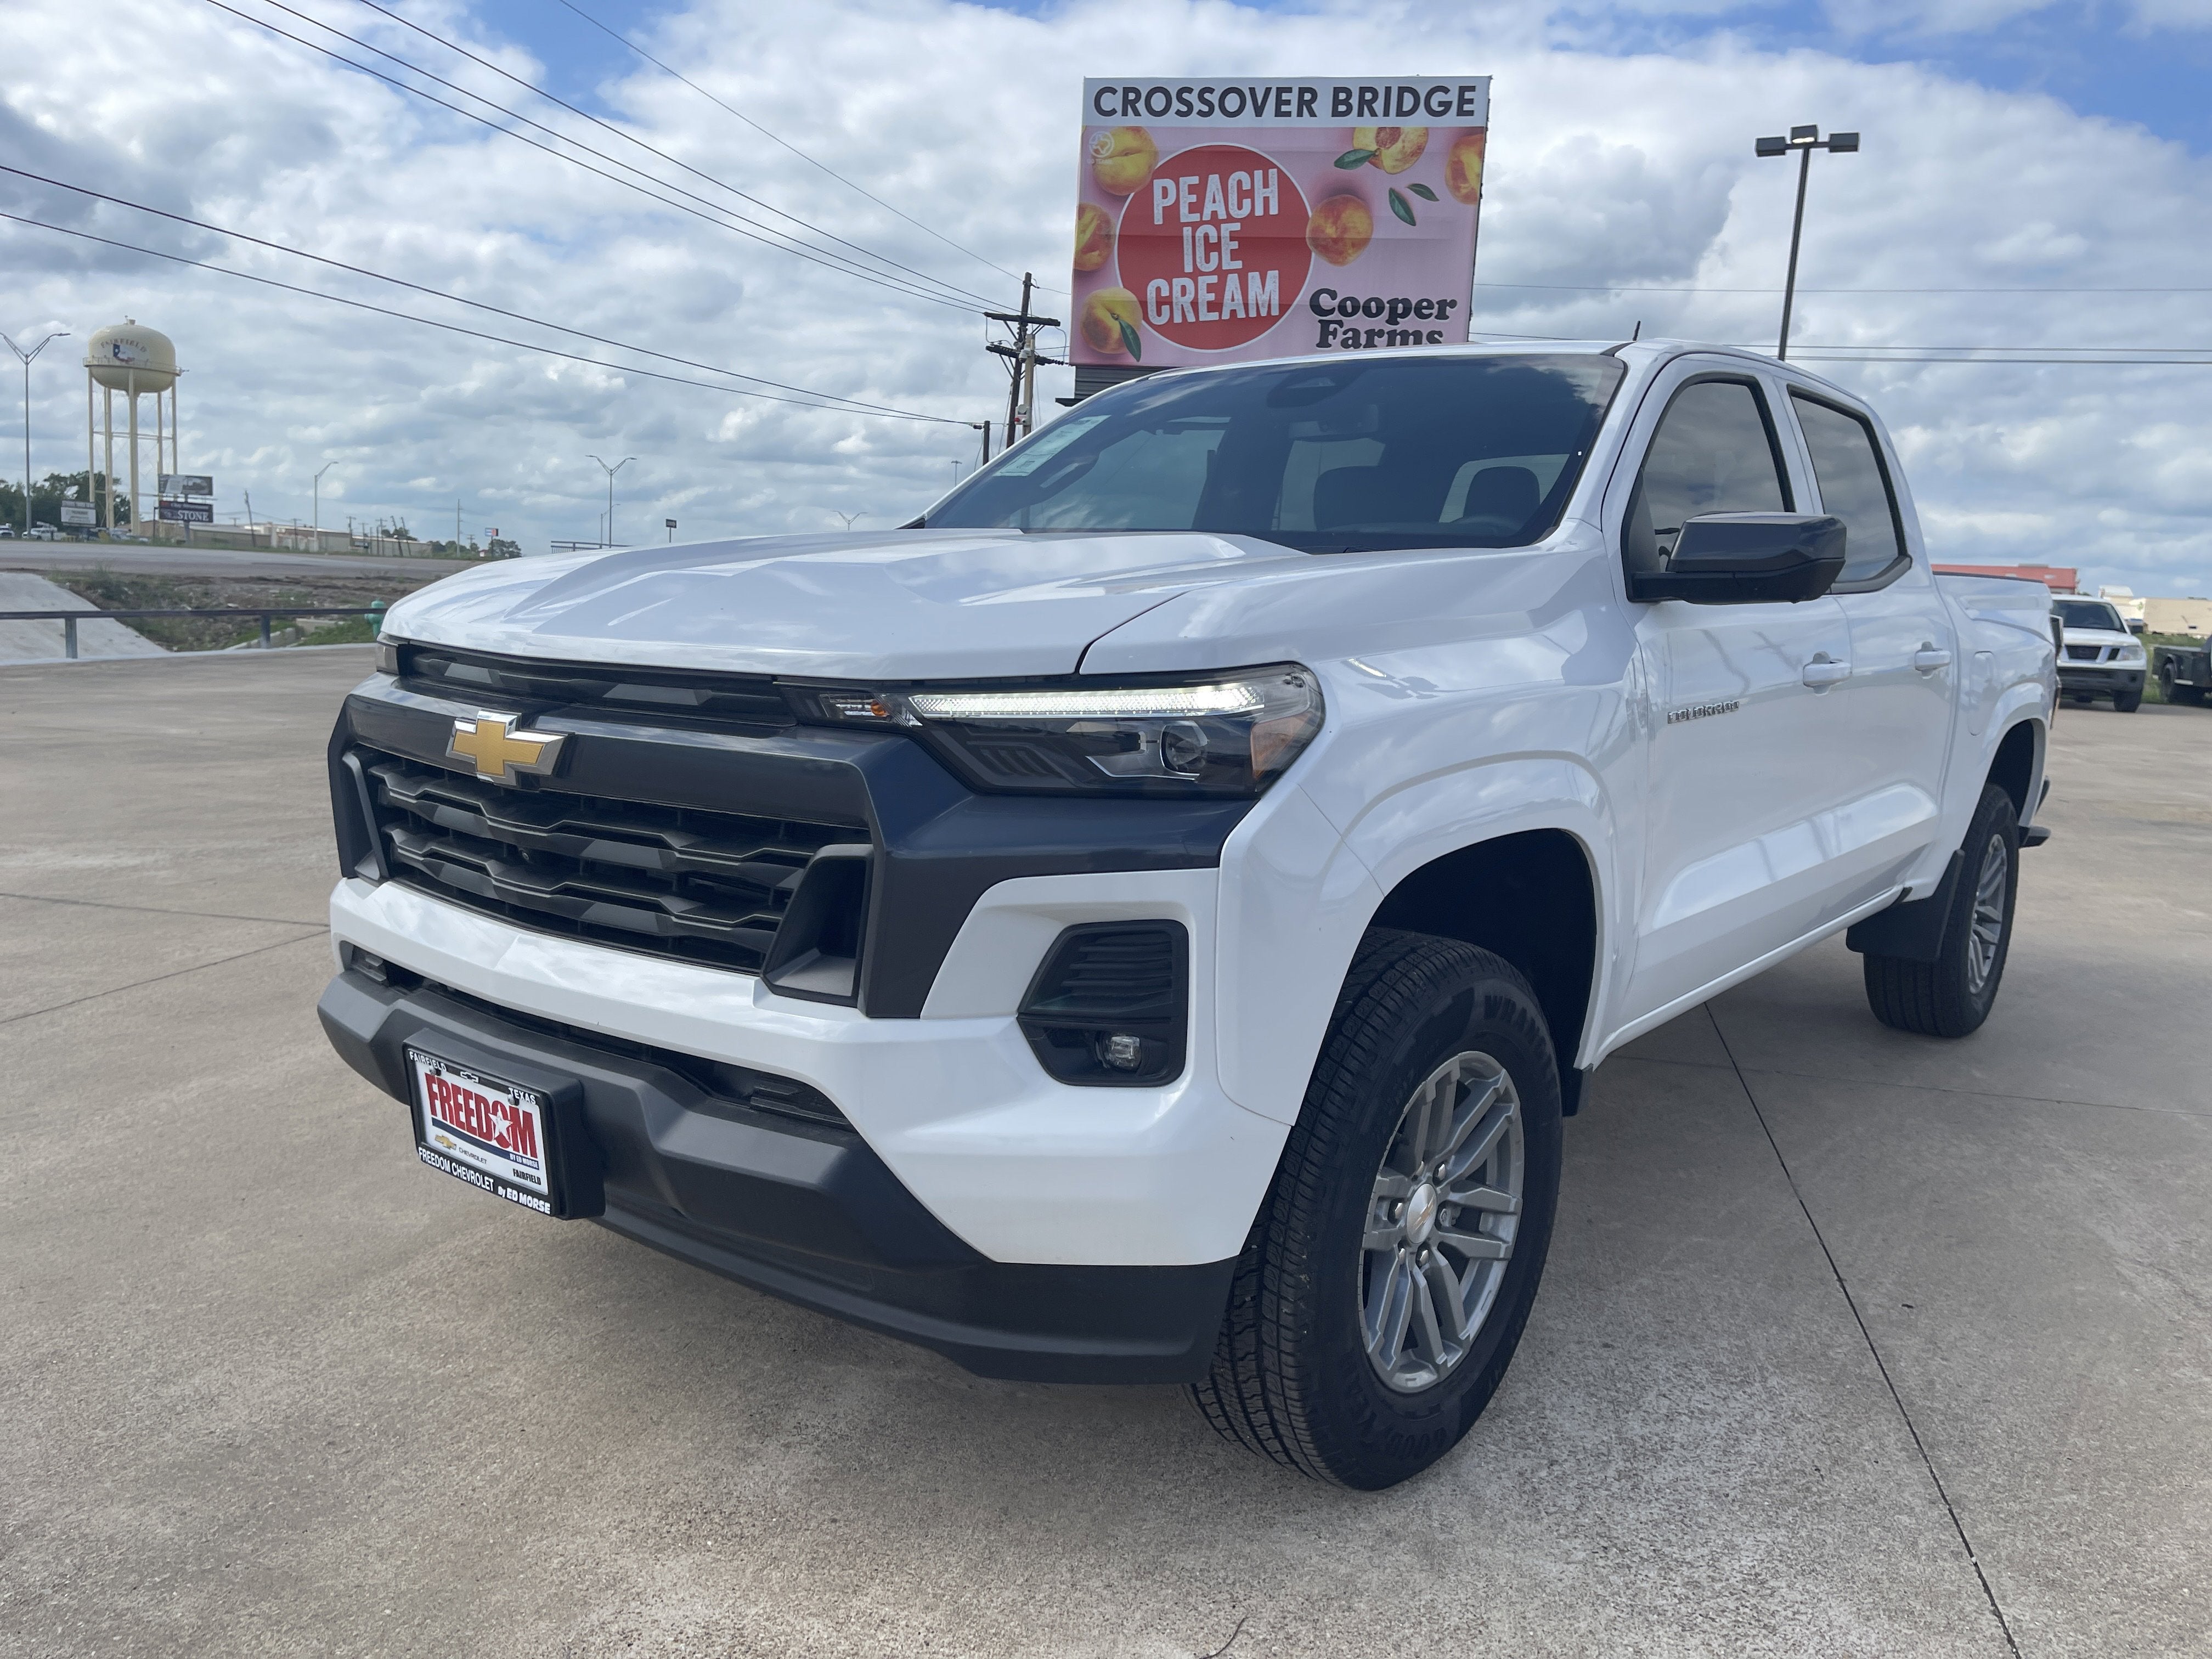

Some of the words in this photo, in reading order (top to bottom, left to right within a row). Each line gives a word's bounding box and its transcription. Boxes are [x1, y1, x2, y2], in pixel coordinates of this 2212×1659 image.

[1093, 86, 1318, 118] CROSSOVER
[1331, 84, 1476, 117] BRIDGE
[1153, 167, 1279, 225] PEACH
[1183, 222, 1243, 273] ICE
[1146, 269, 1280, 326] CREAM
[1309, 287, 1458, 326] Cooper
[1316, 319, 1443, 349] Farms
[178, 510, 209, 521] STONE
[409, 1051, 447, 1072] FAIRFIELD
[508, 1087, 536, 1105] TEXAS
[425, 1072, 538, 1159] FREEDOM
[459, 1147, 487, 1164] CHEVROLET
[513, 1168, 541, 1185] FAIRFIELD
[418, 1147, 450, 1173] FREEDOM
[452, 1162, 494, 1192] CHEVROLET
[506, 1187, 518, 1201] ED
[519, 1192, 551, 1215] MORSE
